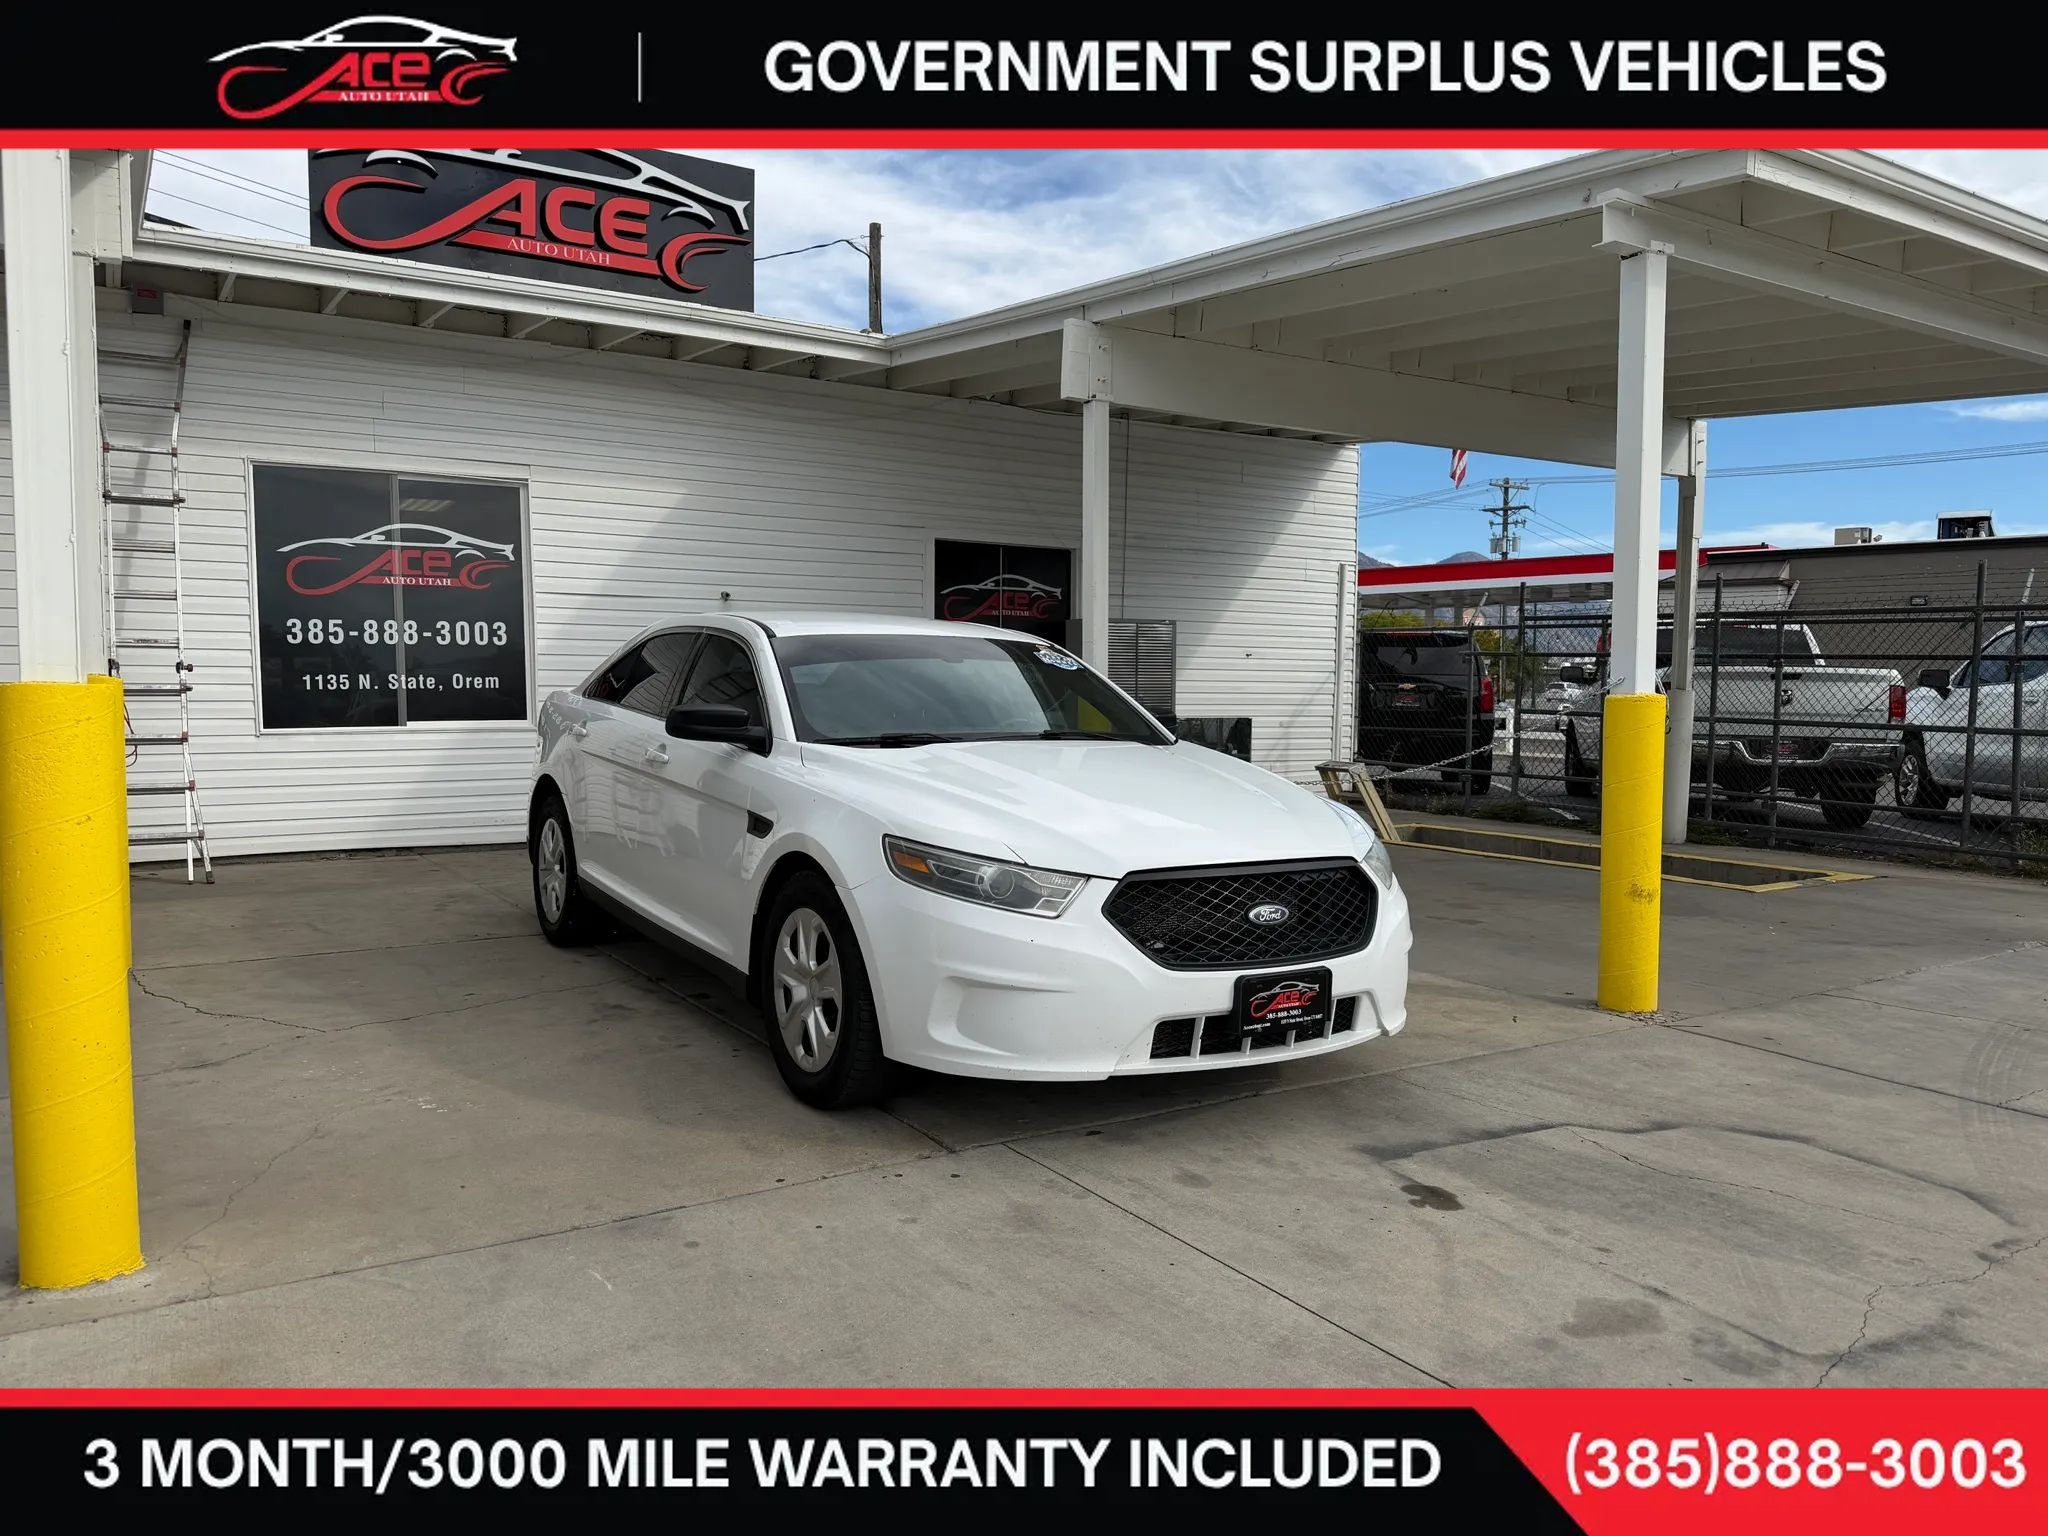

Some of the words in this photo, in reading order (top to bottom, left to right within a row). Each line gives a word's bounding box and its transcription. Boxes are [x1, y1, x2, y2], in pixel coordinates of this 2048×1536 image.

[507, 238, 558, 257] AUTO
[563, 249, 610, 266] UTAH
[382, 576, 416, 585] AUTO
[419, 577, 451, 586] UTAH
[286, 618, 508, 648] 385-888-3003
[302, 674, 350, 691] 1135
[358, 673, 379, 690] N.
[388, 673, 443, 692] State,
[452, 673, 500, 689] Orem
[1260, 908, 1282, 921] Ford
